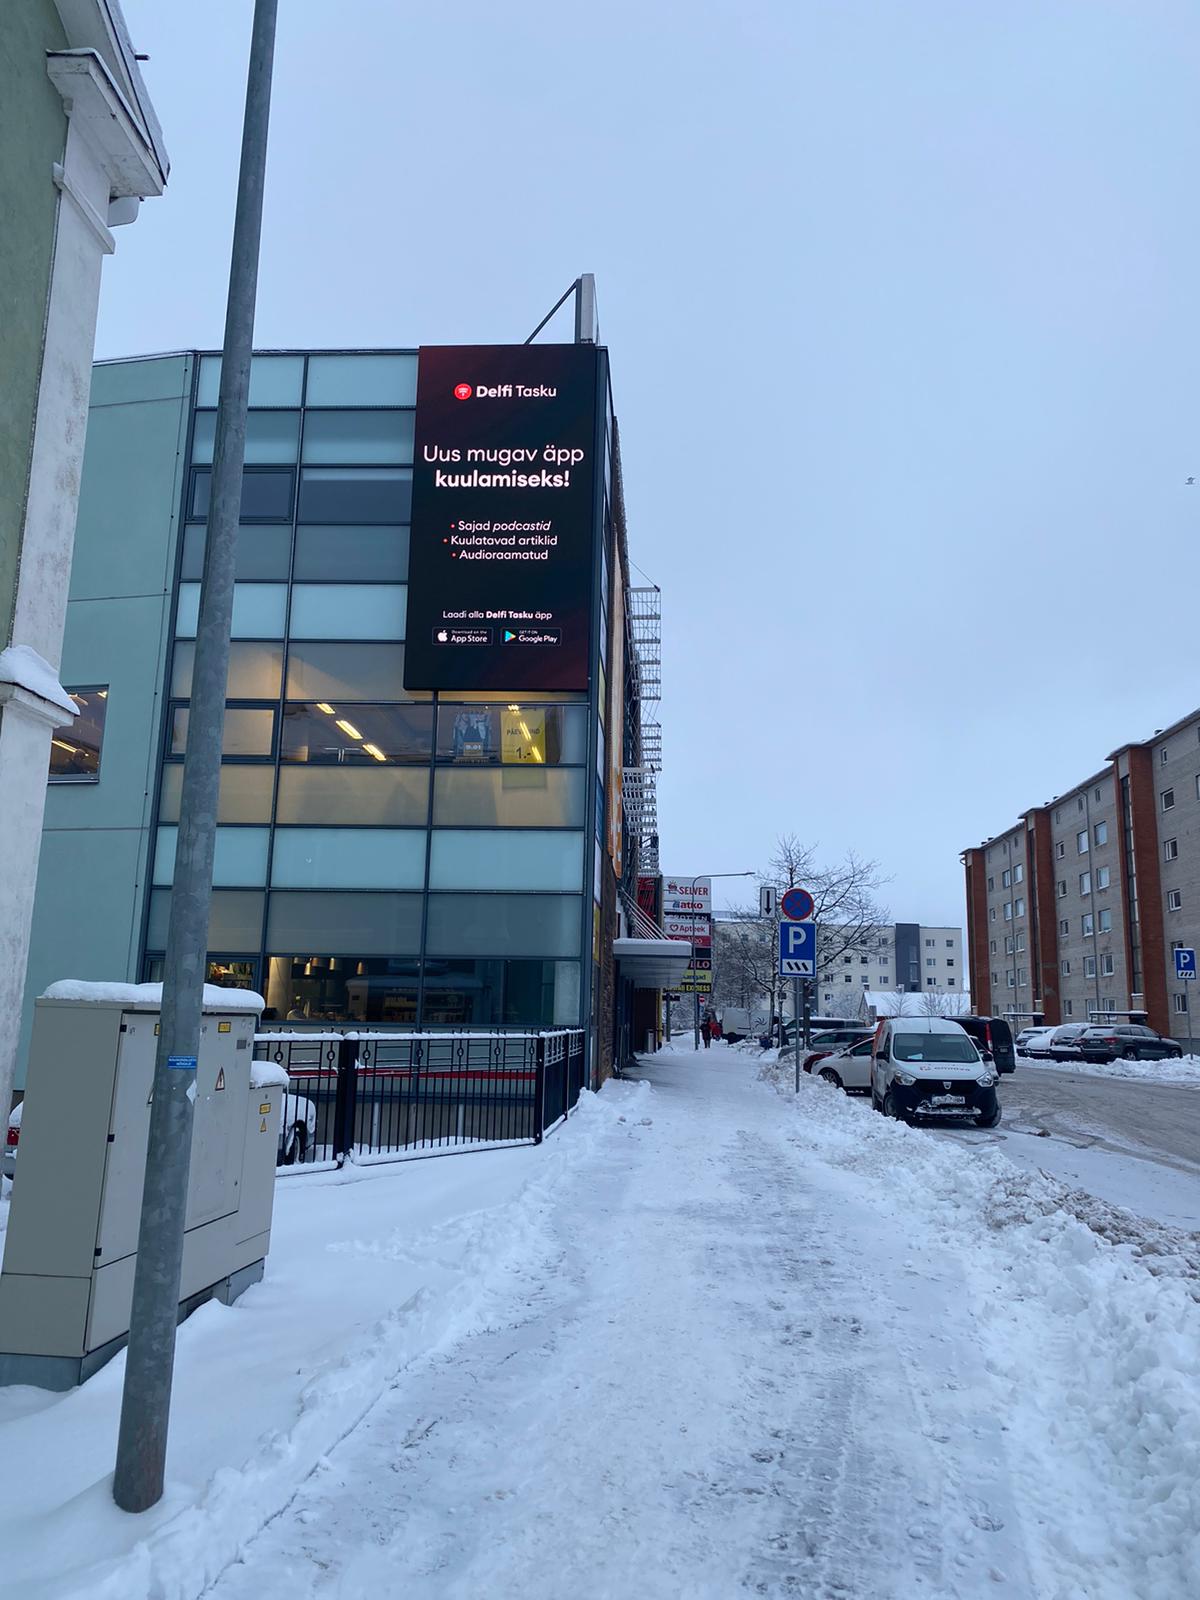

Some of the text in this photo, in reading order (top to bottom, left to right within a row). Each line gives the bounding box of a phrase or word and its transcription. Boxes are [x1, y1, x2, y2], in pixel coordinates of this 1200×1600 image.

[476, 384, 557, 398] Delfi Tasku
[423, 444, 584, 467] Uus mugav äpp
[435, 469, 570, 488] kuulamiseks!
[458, 520, 551, 533] Sajad podcastid
[450, 535, 558, 546] Kuulatavad artiklid
[459, 549, 548, 560] Audioraamatud
[442, 610, 552, 621] Laadi alla Delfi Tasku äpp
[451, 634, 488, 644] App Store
[518, 634, 558, 644] Google Play
[679, 886, 709, 896] SELVER
[788, 926, 807, 954] P
[1180, 952, 1190, 968] P
